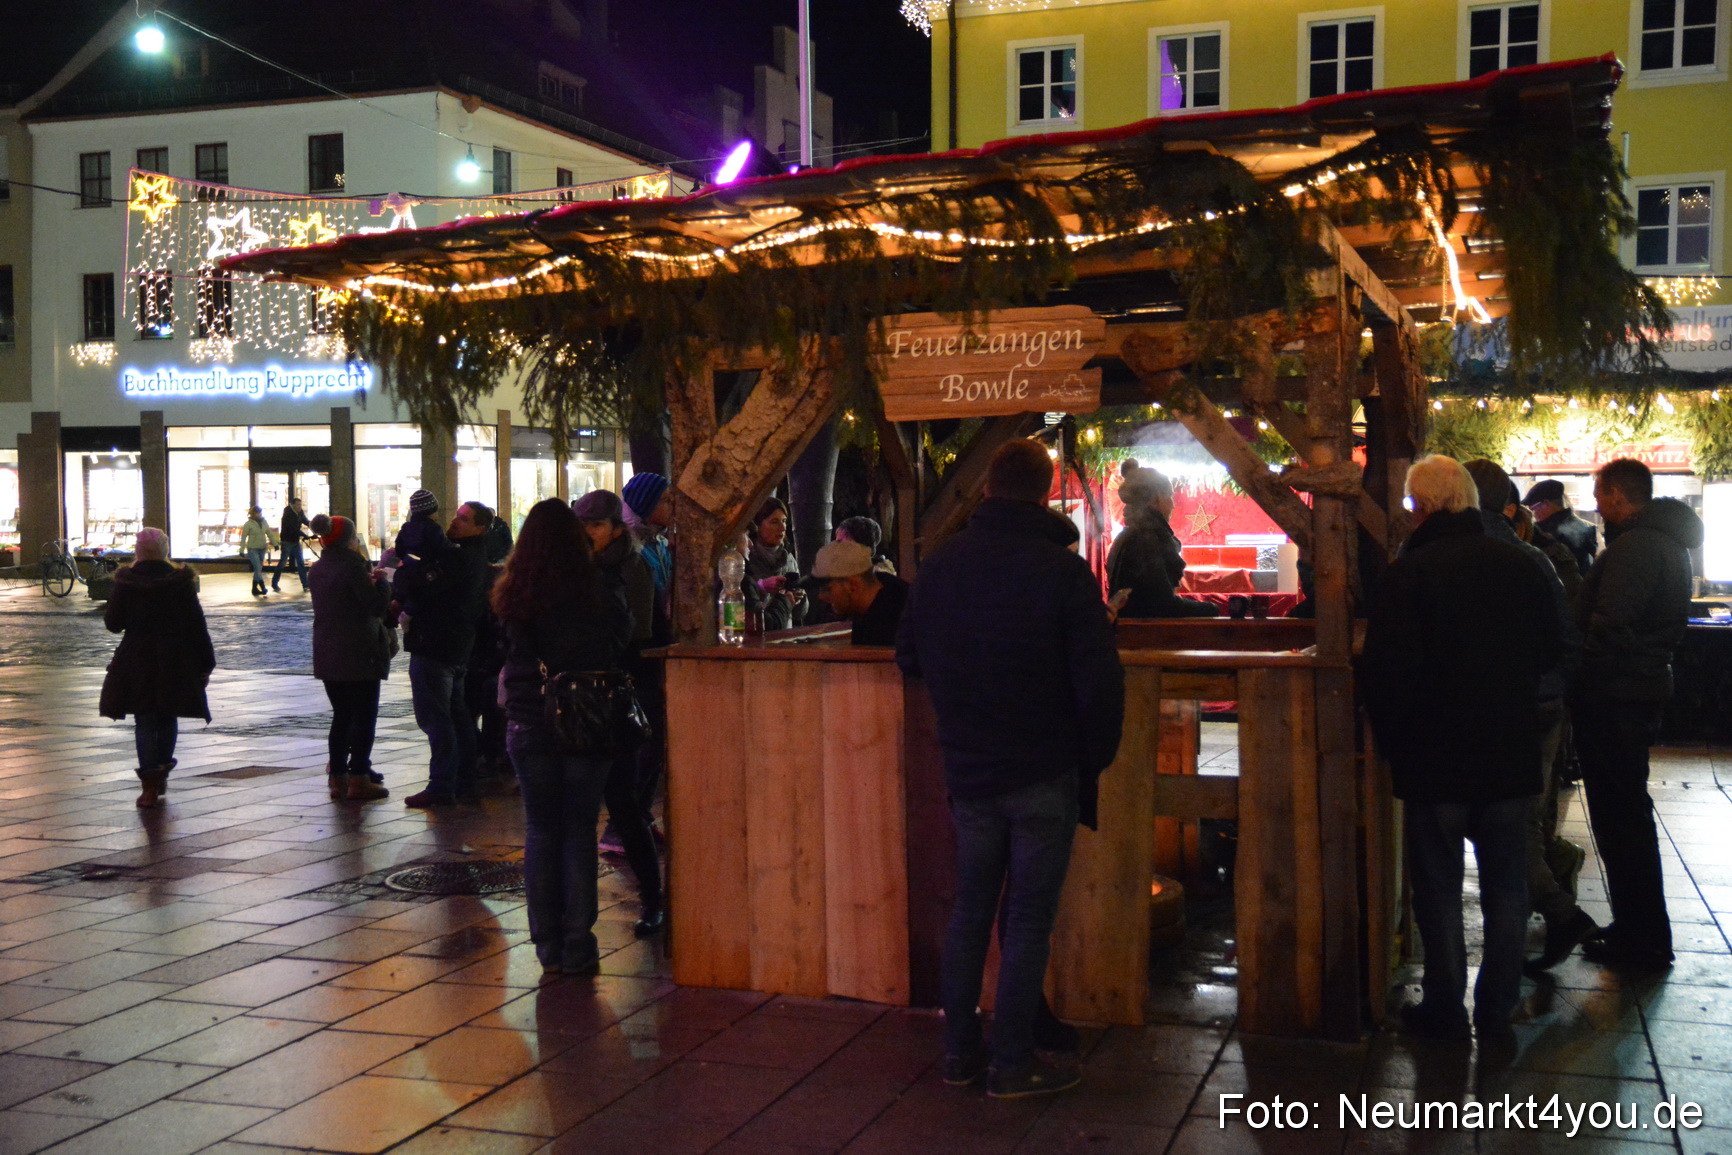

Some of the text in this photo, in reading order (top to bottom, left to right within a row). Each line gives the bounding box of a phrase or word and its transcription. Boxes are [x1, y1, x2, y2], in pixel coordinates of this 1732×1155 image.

[887, 329, 1084, 367] Feuerzangen
[125, 370, 368, 394] Buchhandlung Rupprecht
[940, 364, 1029, 402] Bowle
